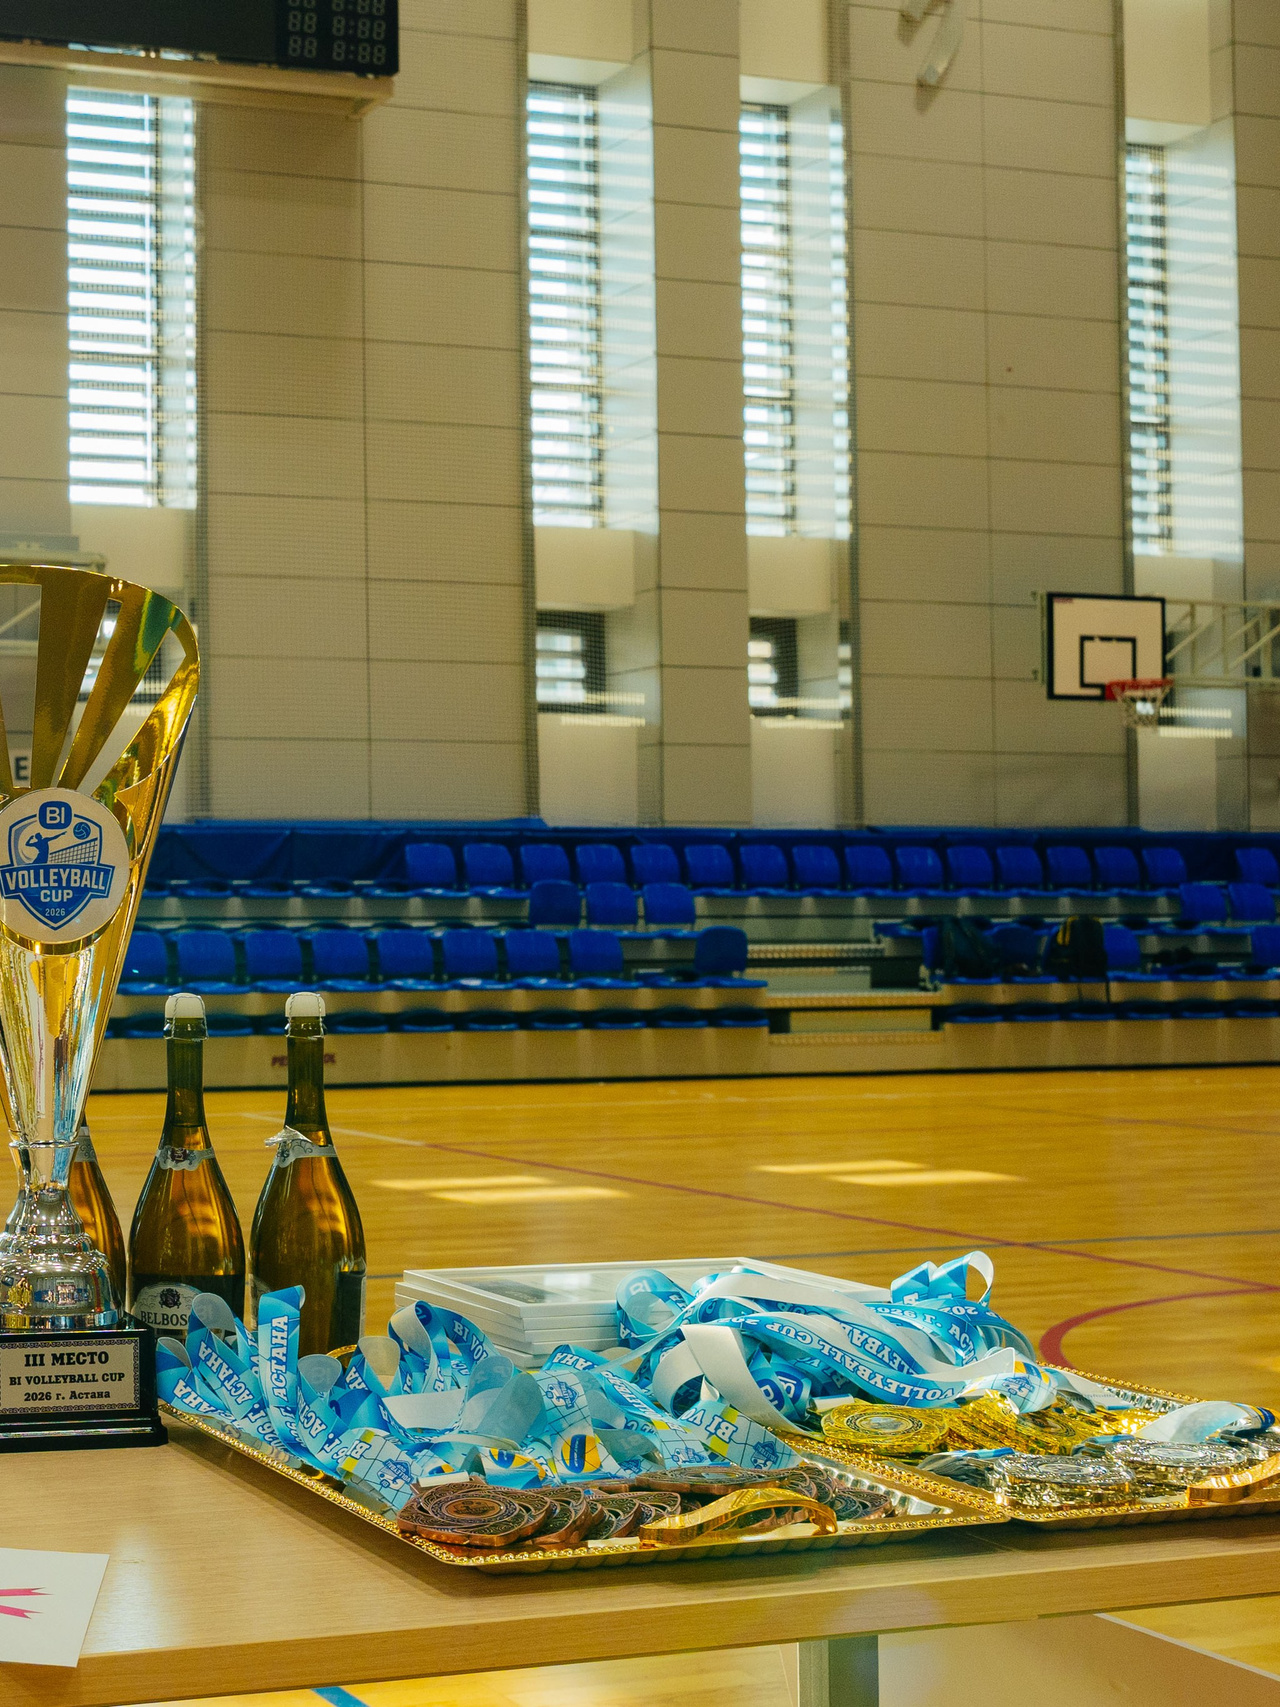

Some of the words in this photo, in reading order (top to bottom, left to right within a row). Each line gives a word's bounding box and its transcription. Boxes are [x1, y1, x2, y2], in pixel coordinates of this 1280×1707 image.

[46, 807, 65, 824] BI
[5, 868, 106, 890] VOLLEYBALL
[40, 890, 74, 902] CUP
[45, 908, 66, 916] 2026
[140, 1310, 189, 1326] BELBOS
[454, 1320, 470, 1342] BI
[766, 1323, 813, 1344] CUP
[24, 1354, 45, 1367] III
[51, 1351, 109, 1366] МЕСТО
[271, 1316, 288, 1401] АСТАНА
[9, 1376, 22, 1386] BI
[25, 1374, 98, 1385] VOLLEYBALL
[102, 1372, 126, 1382] CUP
[199, 1342, 253, 1404] АСТАНА
[818, 1340, 954, 1400] VOLLEYBALL
[24, 1392, 52, 1402] 2026
[69, 1390, 110, 1400] Астана
[706, 1416, 736, 1442] BI
